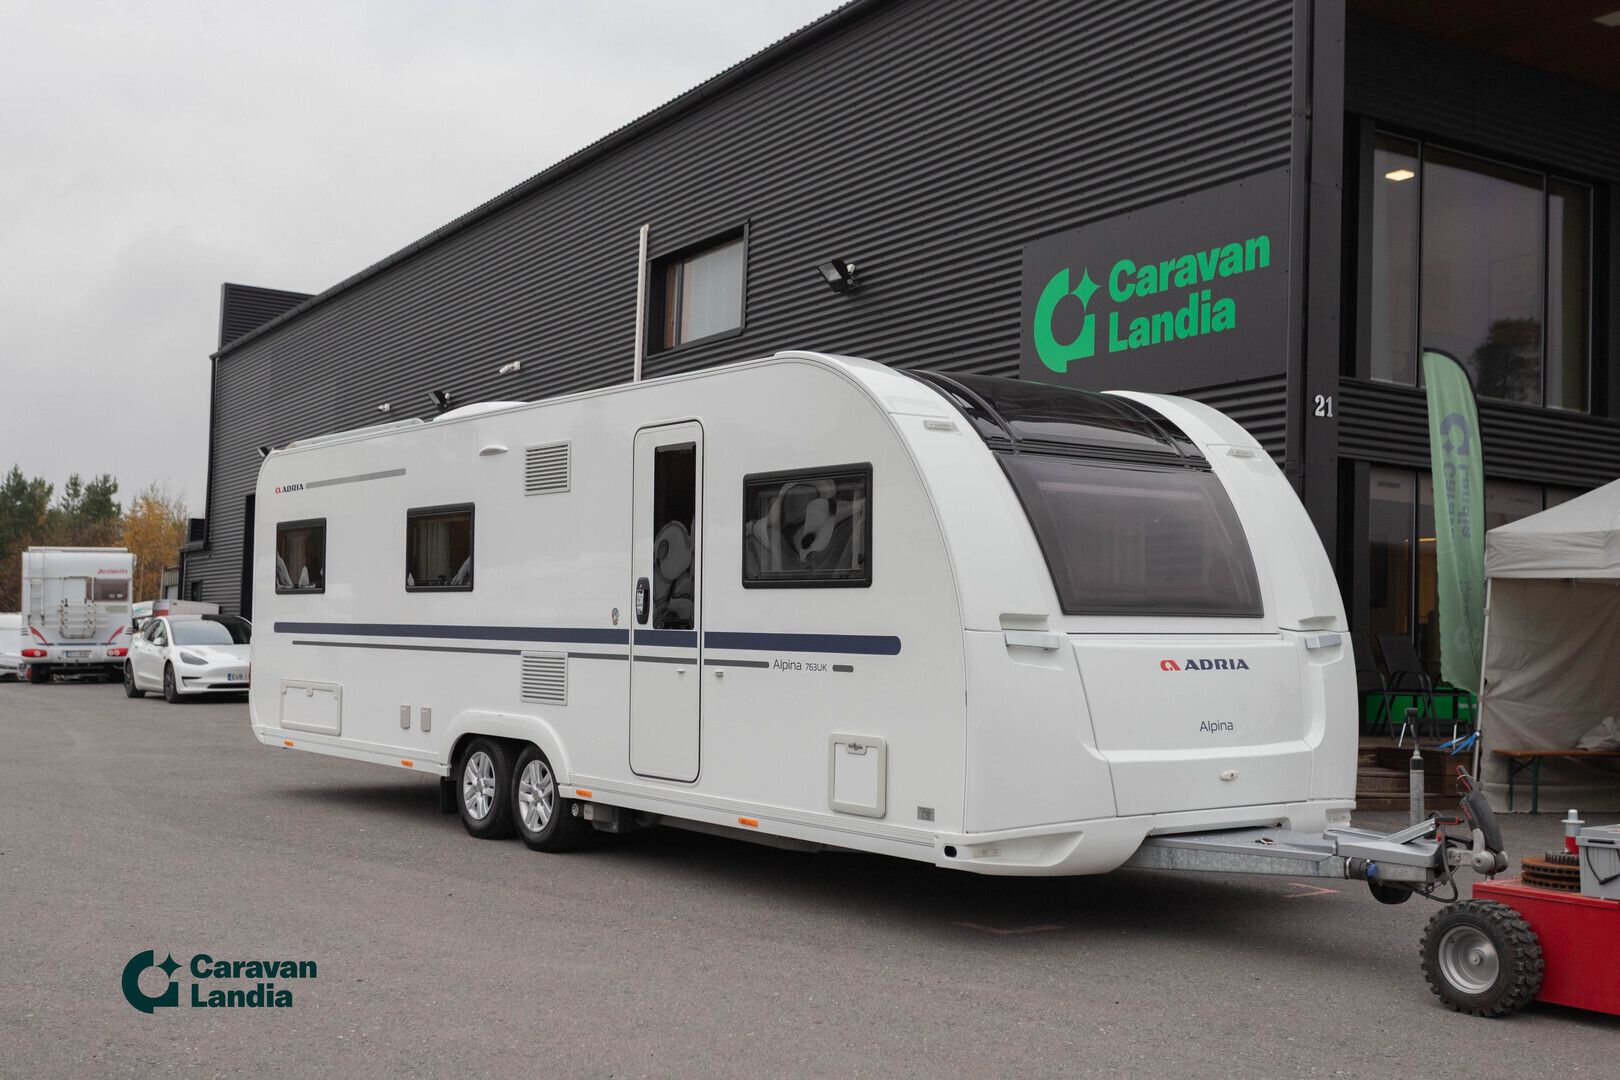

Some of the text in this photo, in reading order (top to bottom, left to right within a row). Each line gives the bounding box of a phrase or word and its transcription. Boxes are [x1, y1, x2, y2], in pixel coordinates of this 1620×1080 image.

[1108, 235, 1270, 302] Caravan
[1108, 289, 1236, 353] Landia
[1314, 394, 1333, 418] 21
[282, 483, 304, 493] ADRIA
[773, 659, 827, 672] Alpina 763UK
[1185, 658, 1250, 671] ADRIA
[1199, 719, 1234, 734] Alpina
